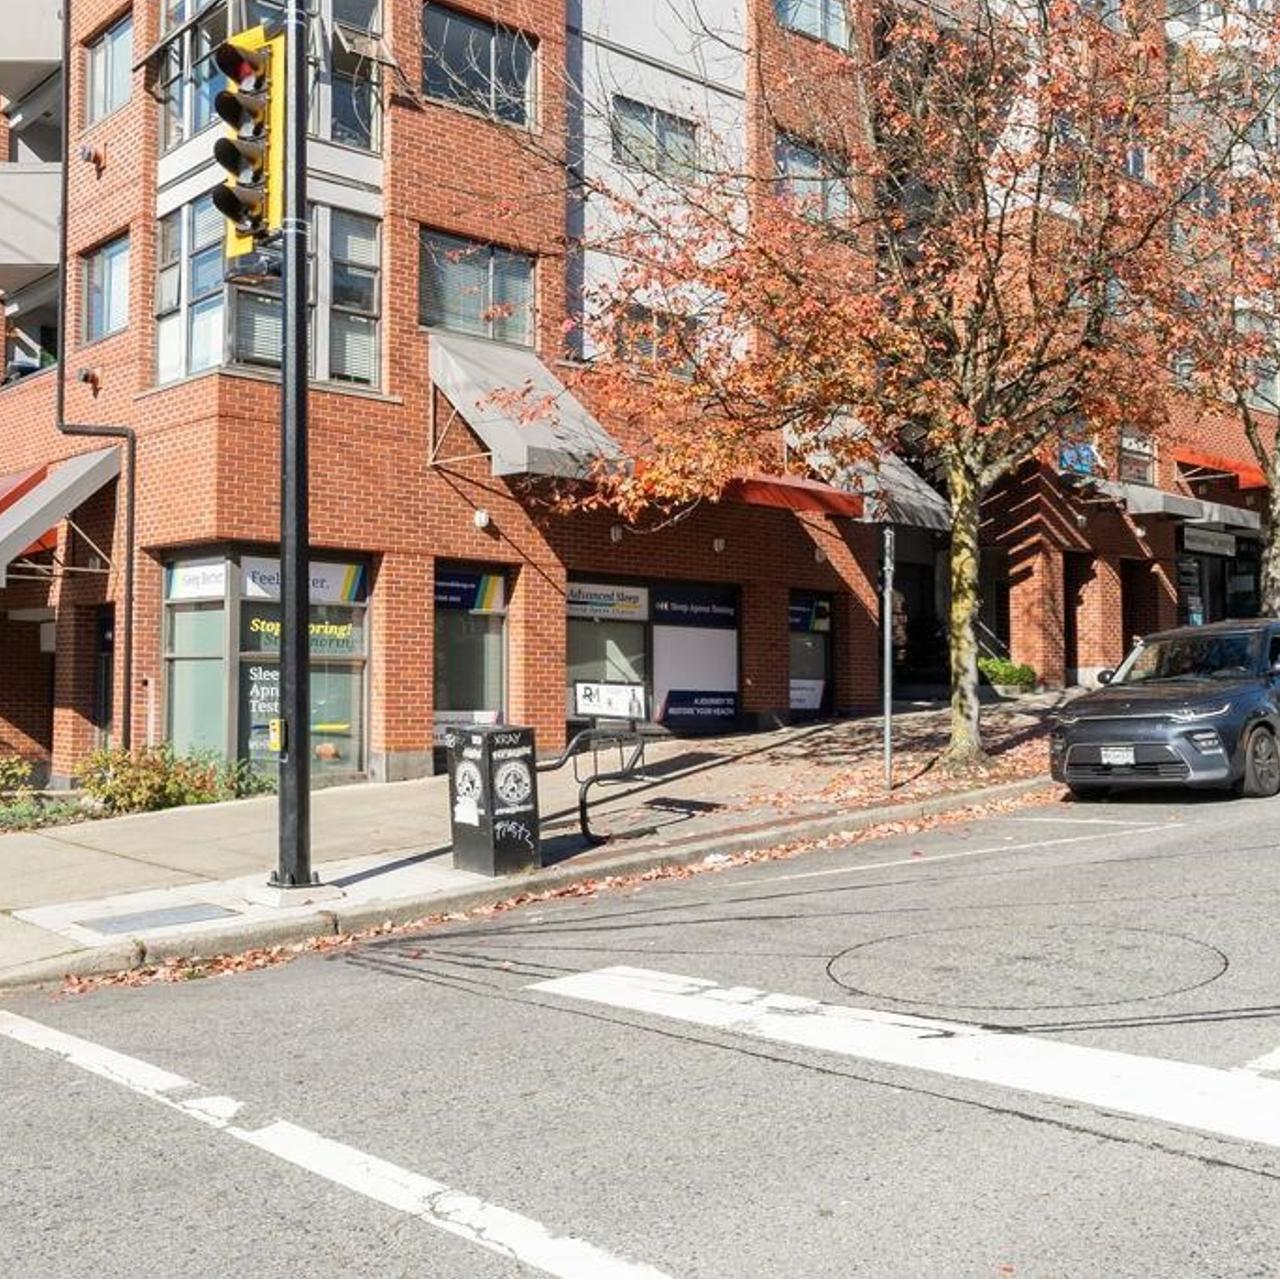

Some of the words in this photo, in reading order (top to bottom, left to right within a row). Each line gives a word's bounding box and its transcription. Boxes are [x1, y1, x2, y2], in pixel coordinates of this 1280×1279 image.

[250, 570, 280, 584] Feel
[249, 617, 281, 635] Stop
[308, 620, 353, 639] oring!
[249, 666, 280, 681] Slee
[249, 682, 280, 700] Apn
[250, 700, 280, 713] Test
